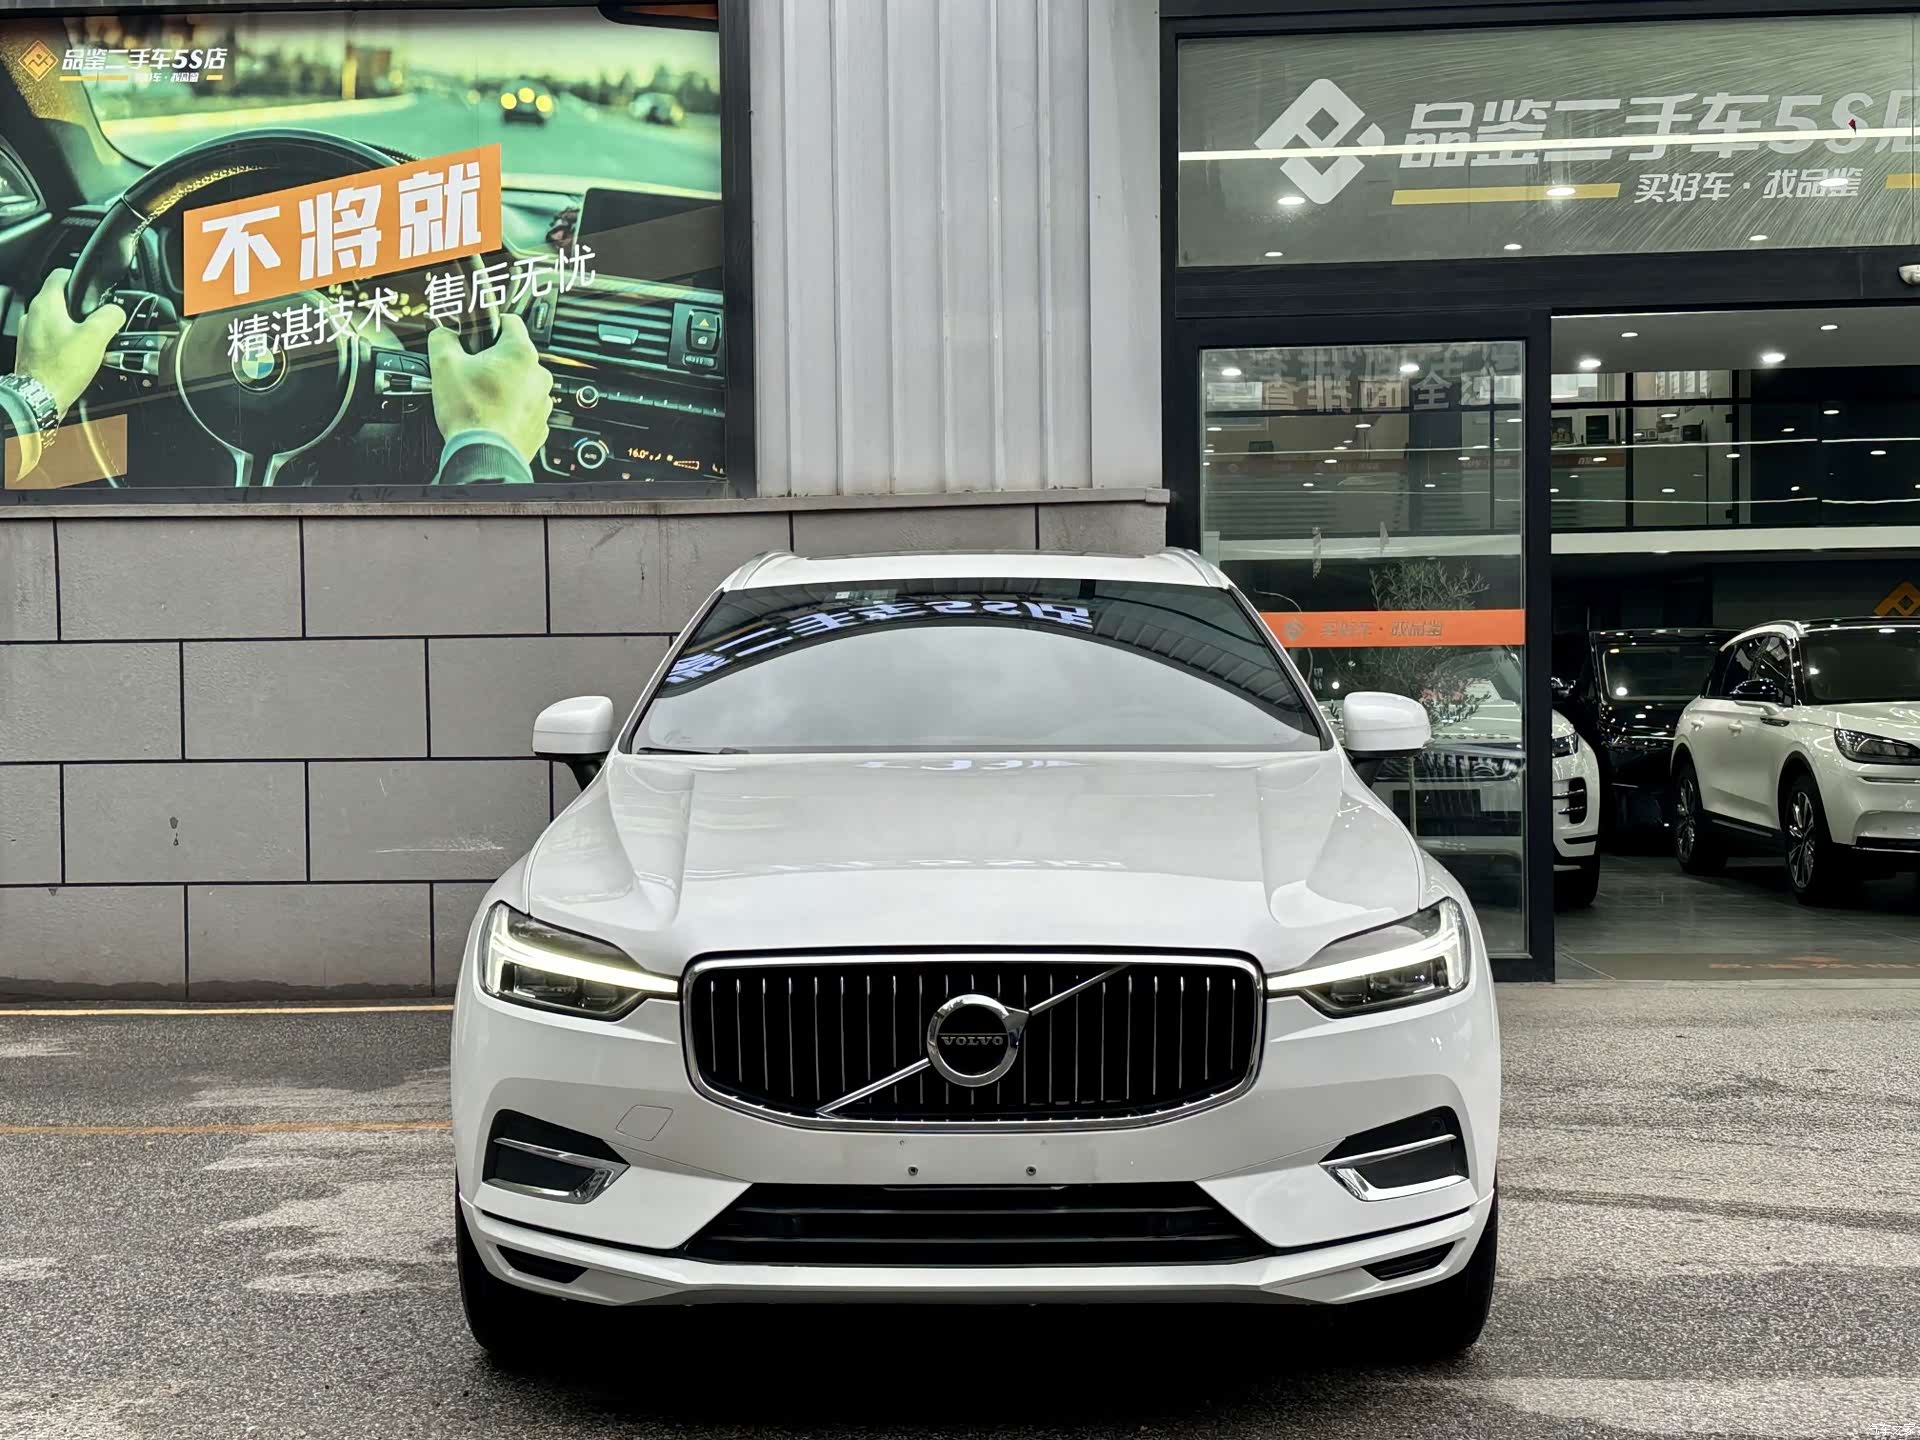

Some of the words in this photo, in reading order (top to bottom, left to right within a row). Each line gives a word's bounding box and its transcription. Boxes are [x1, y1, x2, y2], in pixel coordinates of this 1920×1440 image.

[62, 47, 228, 70] 品鉴二手车5S店
[202, 161, 482, 296] 不将就
[227, 286, 399, 363] 精湛技术
[424, 244, 596, 321] 售后无忧
[941, 1036, 1003, 1046] VOLVO
